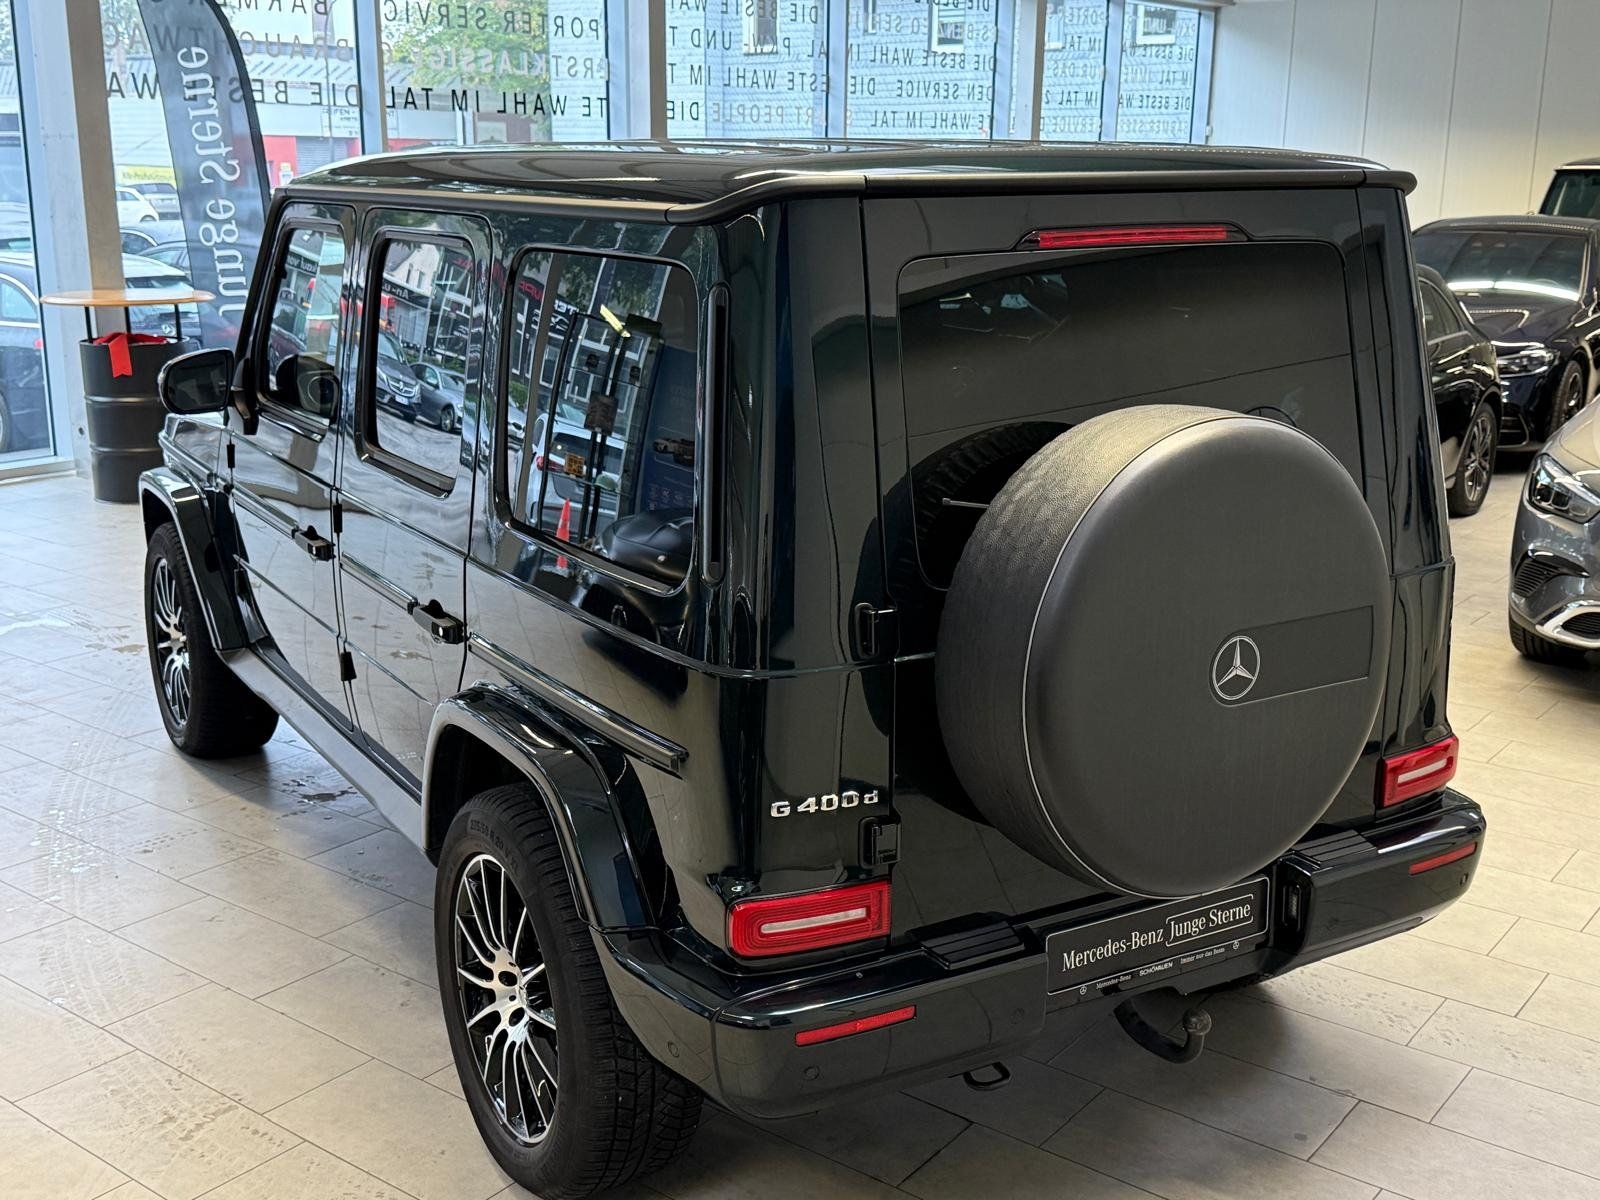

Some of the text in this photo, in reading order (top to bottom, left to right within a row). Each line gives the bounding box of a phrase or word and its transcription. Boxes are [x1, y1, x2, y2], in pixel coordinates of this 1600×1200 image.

[770, 800, 791, 818] G
[1062, 902, 1252, 972] Mercedes-Benz Junge Sterne
